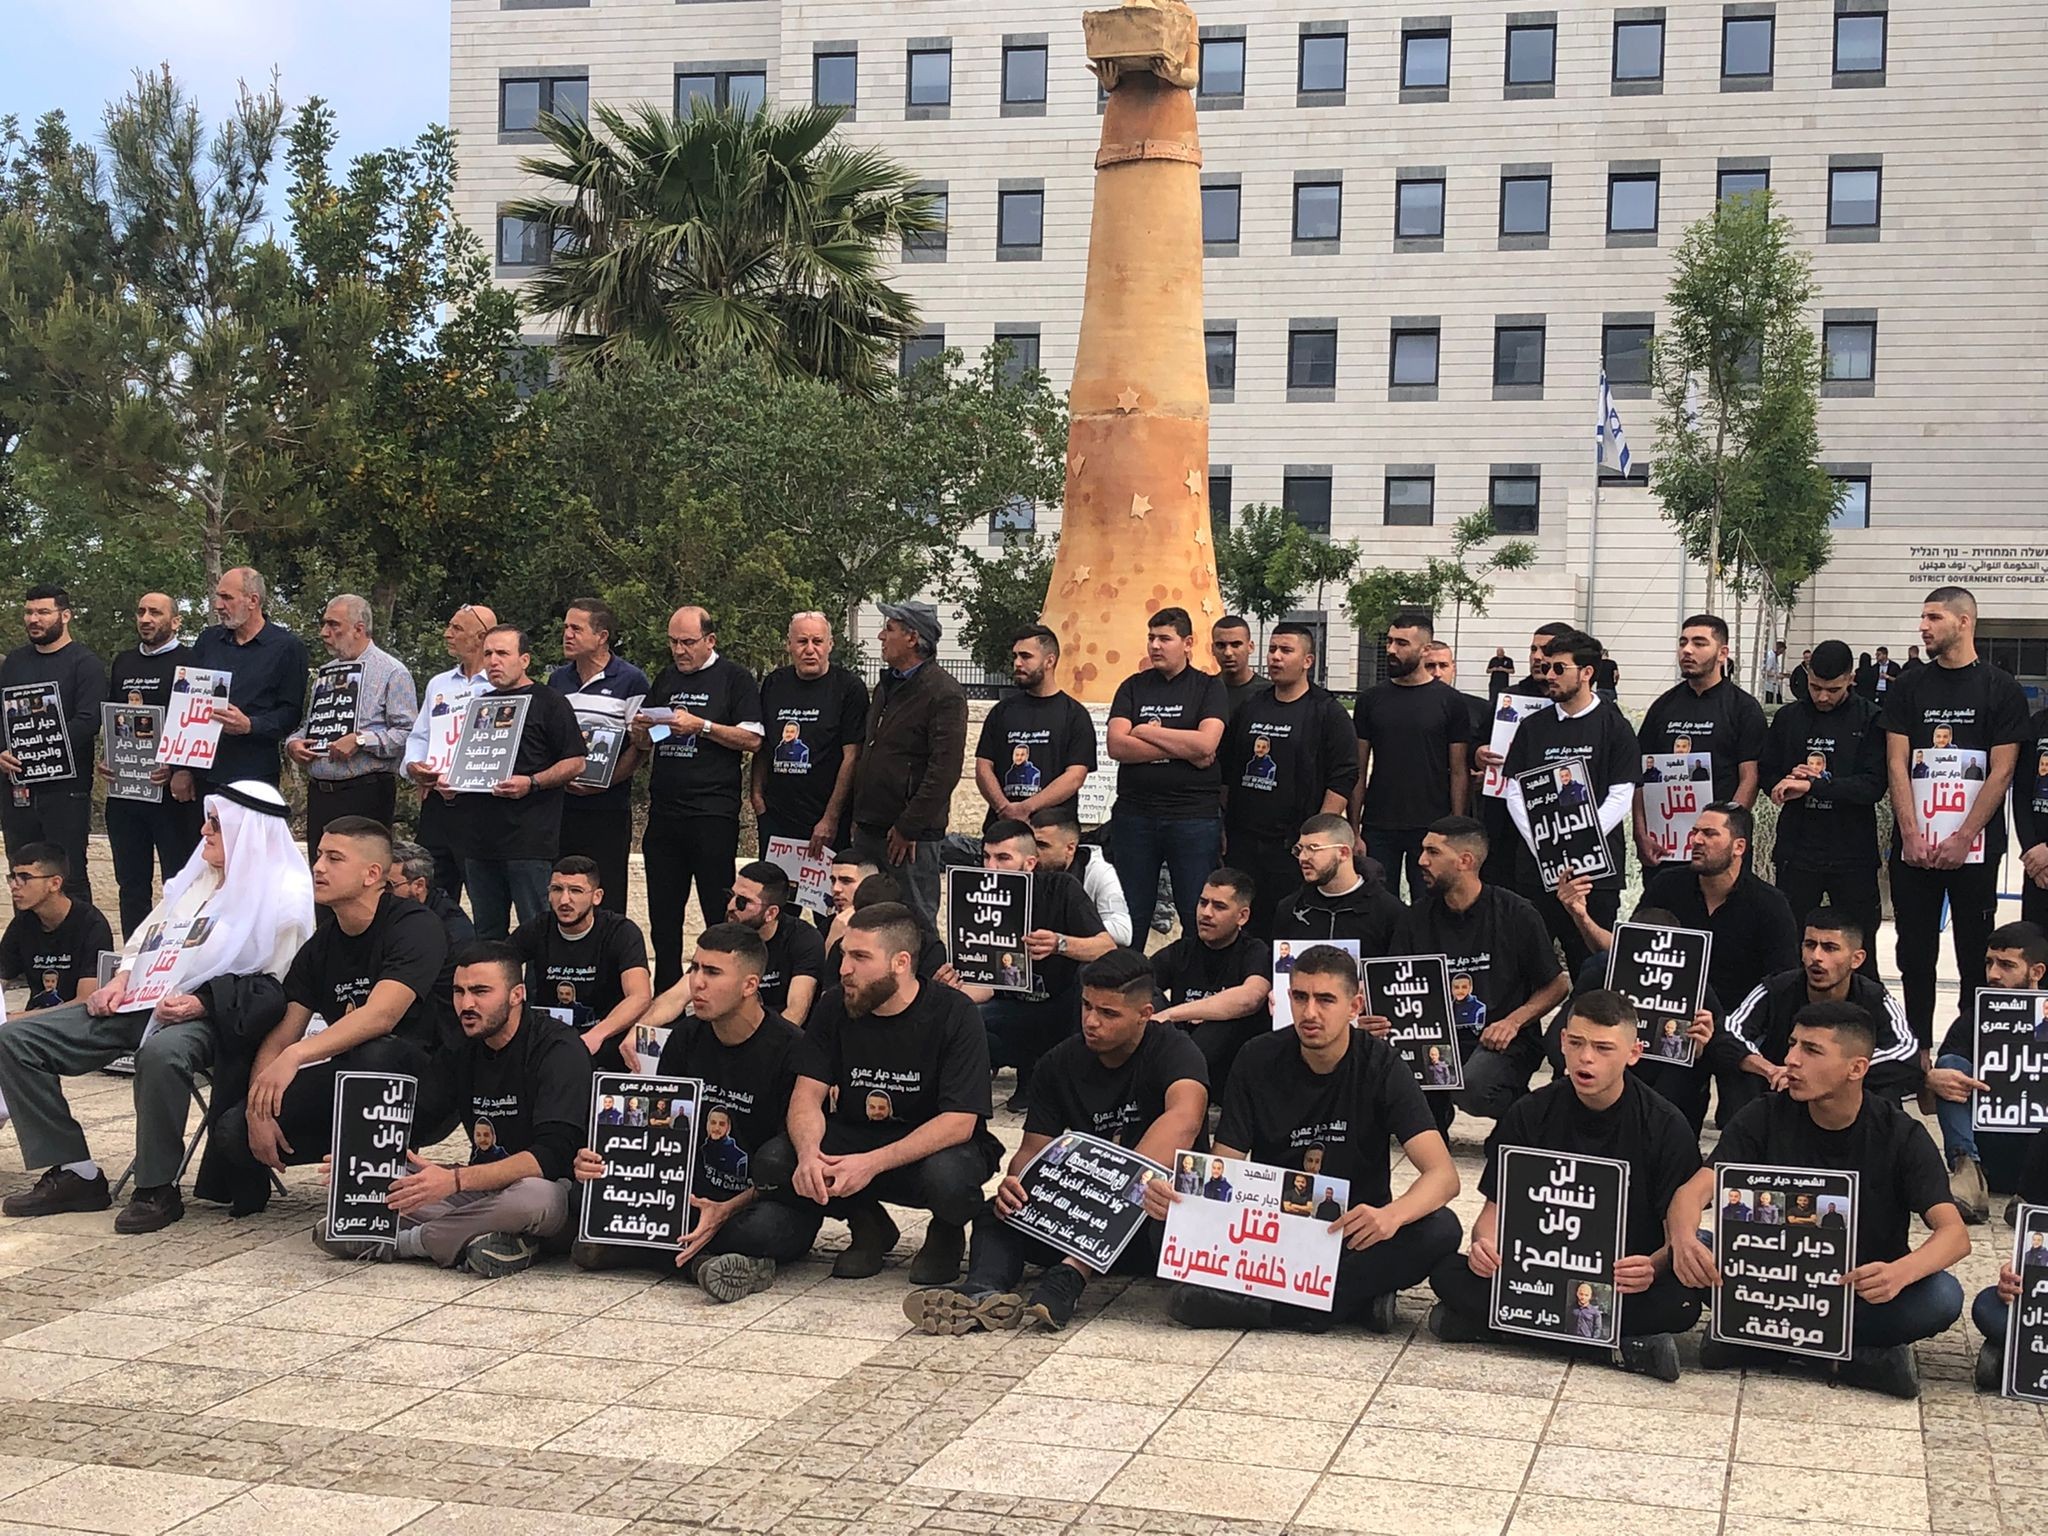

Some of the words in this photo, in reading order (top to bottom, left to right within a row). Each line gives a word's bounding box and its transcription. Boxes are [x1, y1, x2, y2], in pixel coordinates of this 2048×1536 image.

[1910, 546, 1939, 556] הגליל
[1944, 548, 1958, 558] נוף
[2003, 562, 2040, 571] الحكومة
[1909, 575, 1945, 583] DISTRICT
[1948, 575, 2003, 583] GOVERNMENT
[314, 693, 334, 709] أعدم
[333, 695, 353, 706] ديار
[180, 697, 213, 729] قتل
[336, 711, 355, 721] في
[12, 718, 35, 733] أعدم
[39, 717, 56, 731] ديار
[309, 722, 348, 735] والجريمة
[45, 732, 63, 744] في
[470, 732, 490, 742] ديار
[491, 730, 509, 740] قتل
[11, 737, 43, 749] الميدان
[115, 739, 133, 749] ديار
[135, 738, 153, 750] قتل
[159, 731, 188, 763] بارد
[17, 748, 61, 762] والجريمة
[114, 753, 137, 765] تنفيذ
[186, 739, 216, 767] بدم
[464, 745, 490, 758] تنفيذ
[491, 748, 507, 758] هو
[140, 757, 155, 767] هو
[465, 760, 500, 773] لسياسة
[1935, 755, 1958, 765] الشهيد
[25, 765, 63, 777] موثقة.
[119, 769, 152, 780] لسياسة
[1930, 772, 1948, 781] عمري
[1947, 771, 1961, 780] ديار
[460, 776, 485, 787] غفير
[1526, 775, 1551, 790] الشهيد
[120, 783, 141, 796] غفير
[142, 783, 152, 796] بن
[1526, 797, 1544, 811] عمري
[1545, 792, 1559, 805] ديار
[1661, 785, 1697, 820] قتل
[1923, 782, 1966, 820] قتل
[980, 872, 998, 892] لن
[966, 889, 1012, 906] ننسى
[974, 906, 1002, 927] ولن
[958, 927, 1018, 949] نسامح!
[1651, 931, 1673, 951] لن
[145, 950, 180, 978] قتل
[957, 950, 988, 963] الشهيد
[1633, 949, 1686, 968] ننسى
[977, 967, 994, 980] ديار
[1395, 960, 1413, 982] لن
[1639, 966, 1674, 991] ولن
[1383, 976, 1429, 996] ننسى
[1394, 996, 1424, 1018] ولن
[1988, 998, 2028, 1012] الشهيد
[1980, 1020, 2010, 1034] عمري
[2012, 1020, 2034, 1034] ديار
[1979, 1044, 2008, 1081] لم
[851, 1068, 873, 1079] عمري
[874, 1068, 890, 1081] ديار
[891, 1070, 921, 1083] الشهيد
[383, 1081, 404, 1105] لن
[619, 1083, 640, 1095] عمري
[641, 1083, 655, 1096] ديار
[654, 1085, 679, 1099] الشهيد
[362, 1102, 411, 1124] ننسى
[1977, 1090, 2028, 1126] أمنة
[373, 1124, 404, 1153] ولن
[604, 1131, 649, 1154] أعدم
[651, 1136, 682, 1157] ديار
[659, 1165, 685, 1184] في
[1243, 1168, 1277, 1182] الشهيد
[1550, 1159, 1577, 1187] لن
[1746, 1174, 1772, 1186] عمري
[1772, 1176, 1791, 1187] ديار
[1792, 1177, 1826, 1188] الشهيد
[344, 1190, 387, 1206] الشهيد
[603, 1184, 676, 1212] والجريمة
[1235, 1190, 1259, 1204] عمري
[1261, 1193, 1279, 1208] ديار
[1528, 1185, 1596, 1210] ننسى
[335, 1216, 368, 1232] عمري
[369, 1216, 391, 1231] ديار
[603, 1213, 671, 1240] موثقة.
[1229, 1208, 1280, 1244] قتل
[1538, 1207, 1581, 1240] ولن
[1732, 1230, 1787, 1252] أعدم
[1792, 1236, 1836, 1258] ديار
[1163, 1235, 1230, 1279] عنصرية
[1513, 1239, 1603, 1275] نسامح!
[1235, 1250, 1286, 1291] خلفية
[1724, 1258, 1798, 1283] الميدان
[1804, 1268, 1842, 1288] في
[1293, 1265, 1332, 1298] على
[1509, 1280, 1554, 1296] الشهيد
[1735, 1284, 1830, 1317] والجريمة
[1499, 1304, 1533, 1320] عمري
[1535, 1309, 1561, 1325] ديار
[1739, 1315, 1825, 1347] موثقة.
